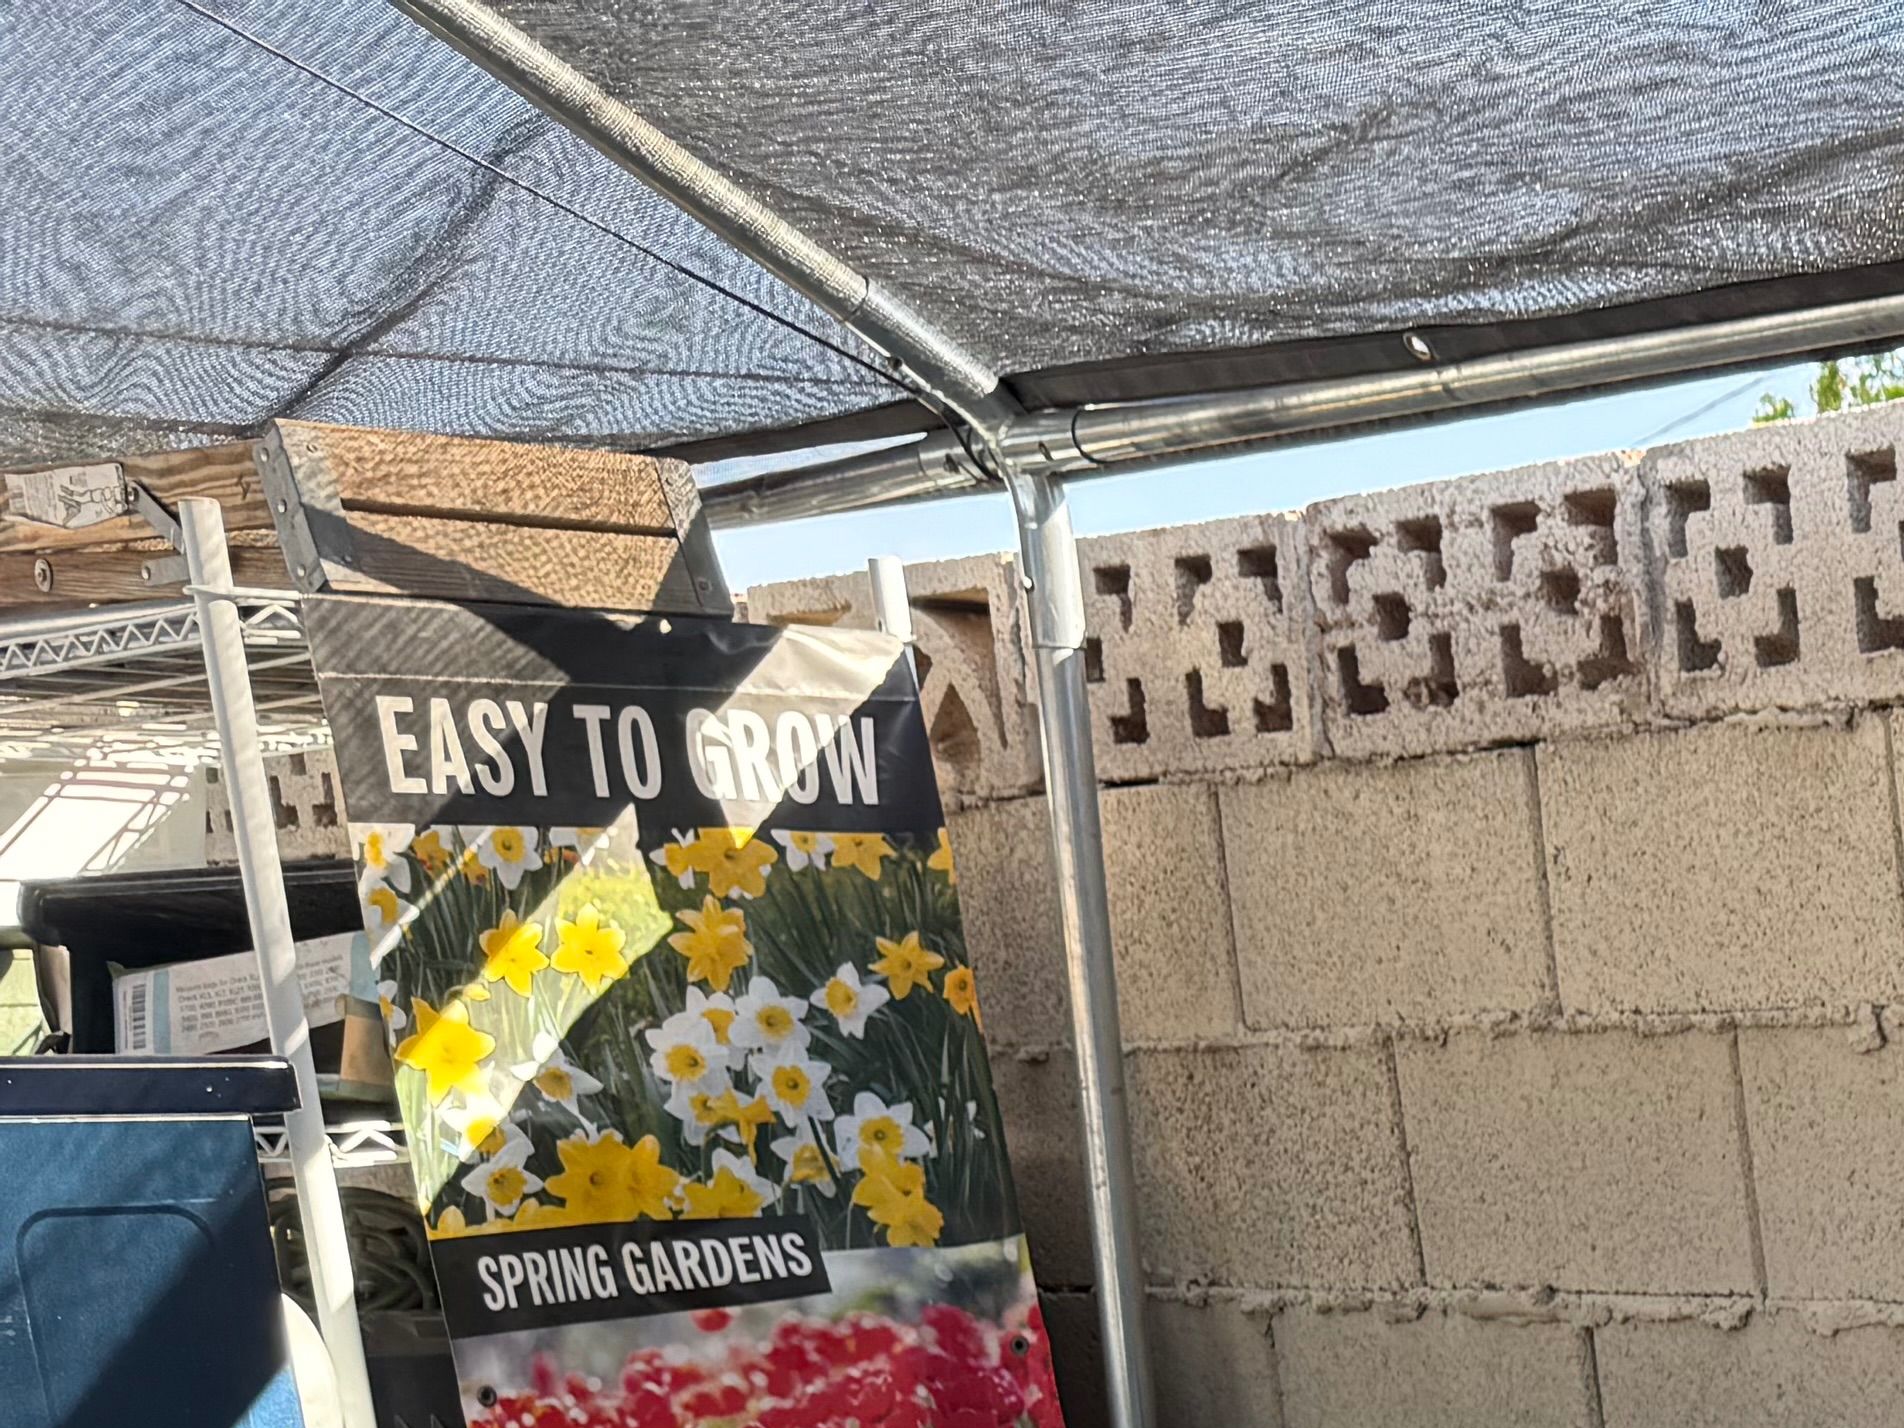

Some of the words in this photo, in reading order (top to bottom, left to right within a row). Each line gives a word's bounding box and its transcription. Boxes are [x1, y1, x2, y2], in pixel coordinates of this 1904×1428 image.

[376, 695, 549, 797] EASY
[573, 704, 663, 801] TO
[686, 708, 879, 806] GROW
[477, 1243, 619, 1313] SPRING
[620, 1231, 813, 1296] GARDENS
